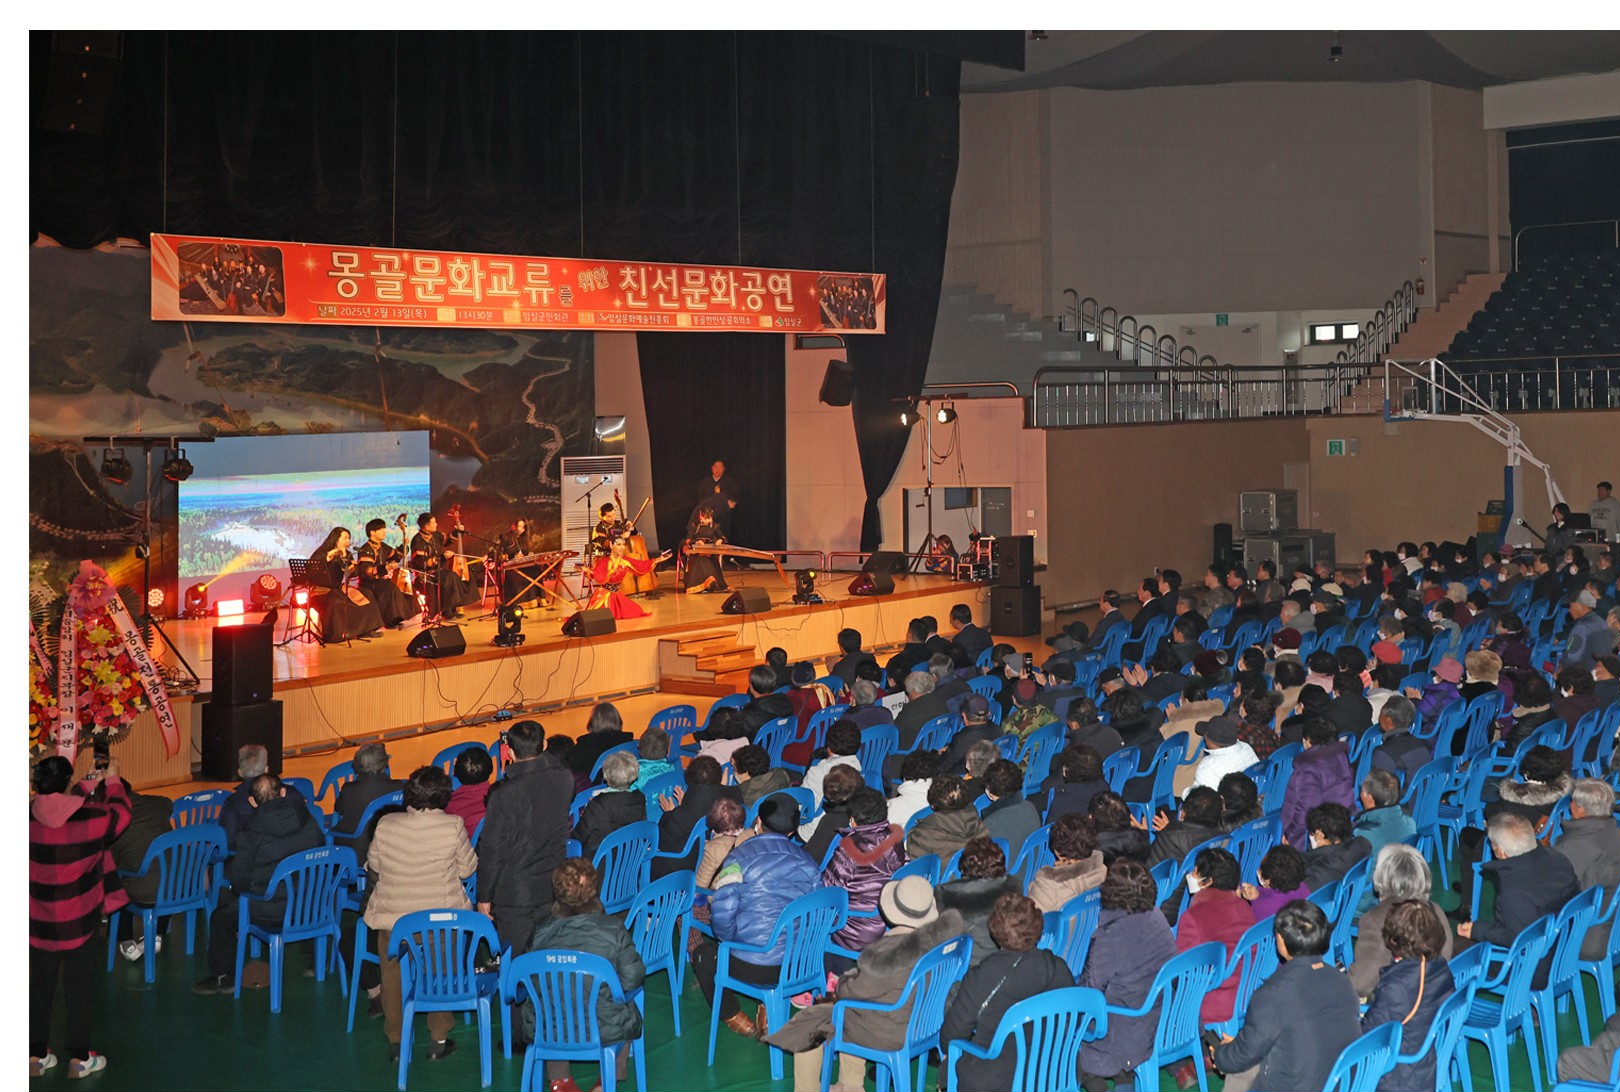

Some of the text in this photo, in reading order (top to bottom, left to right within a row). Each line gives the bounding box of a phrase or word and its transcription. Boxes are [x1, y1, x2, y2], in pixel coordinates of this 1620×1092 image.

[327, 250, 795, 312] 몽골문화교류를 위한 친선문화공연
[340, 306, 371, 318] 2025년
[374, 307, 388, 319] 2월
[392, 308, 427, 319] 13일(목)
[458, 310, 493, 322] 13시30분
